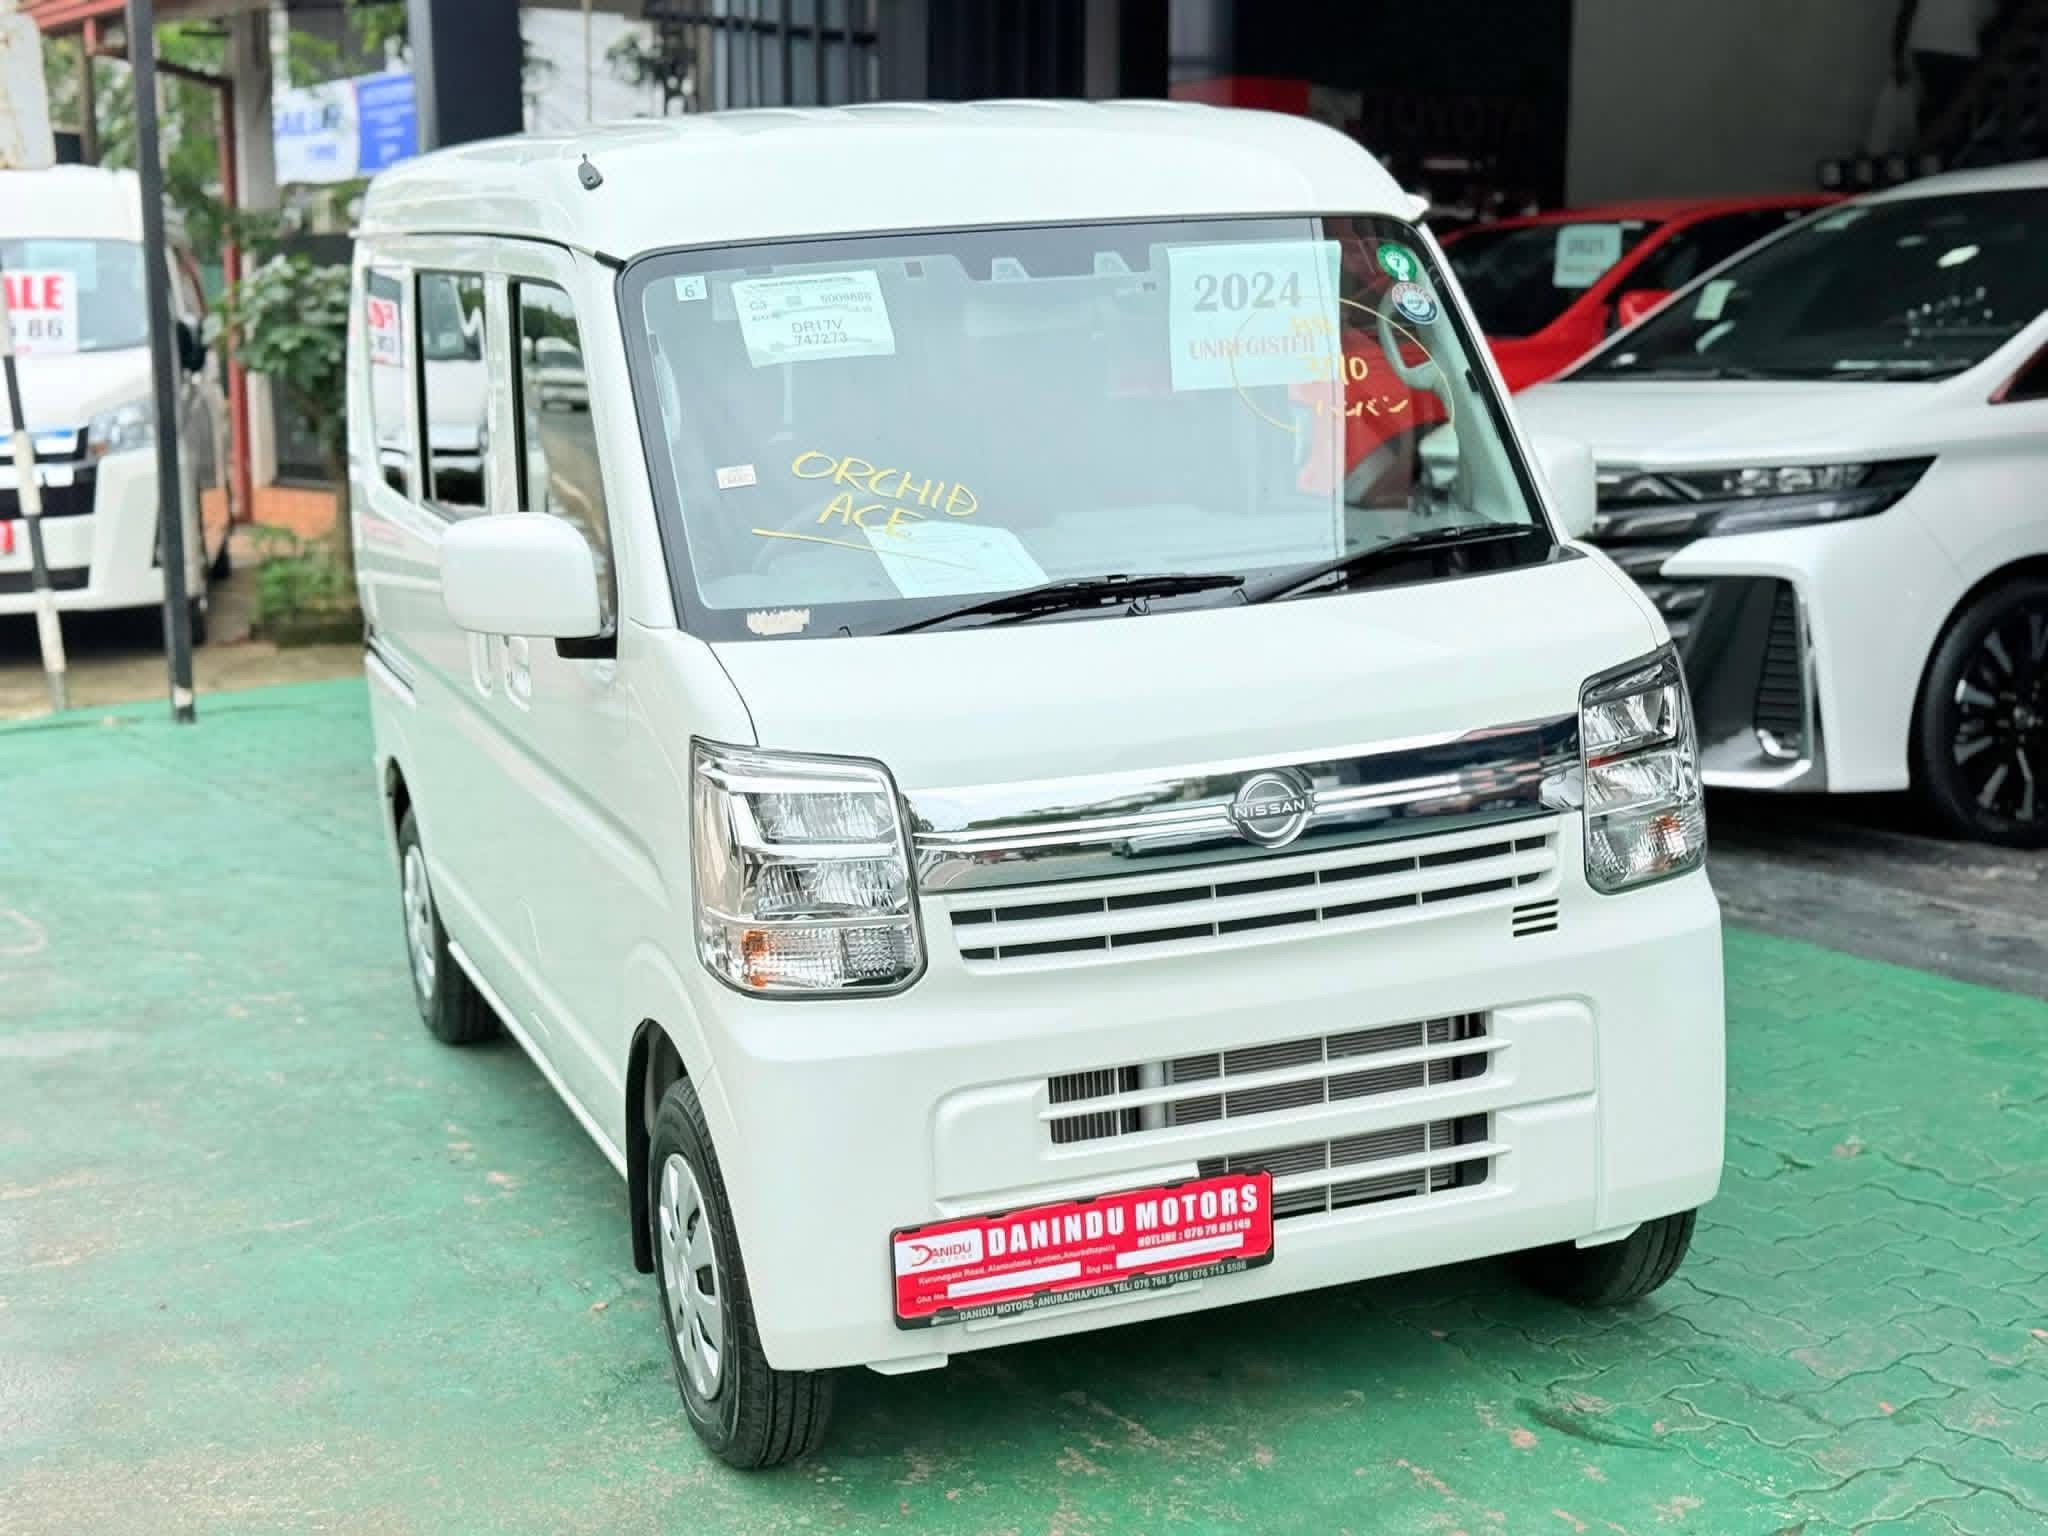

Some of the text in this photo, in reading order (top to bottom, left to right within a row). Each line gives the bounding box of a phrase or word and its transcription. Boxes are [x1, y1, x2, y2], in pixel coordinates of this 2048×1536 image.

[1193, 271, 1304, 313] 2024
[791, 319, 844, 335] DR17V
[793, 331, 849, 347] 747273
[791, 451, 978, 517] ORCHID
[816, 491, 926, 539] ACE
[1233, 799, 1305, 818] NISSAN
[987, 1183, 1259, 1257] DANINDU MOTORS
[1137, 1231, 1177, 1248] HOTLINE
[960, 1307, 995, 1321] DANIDU
